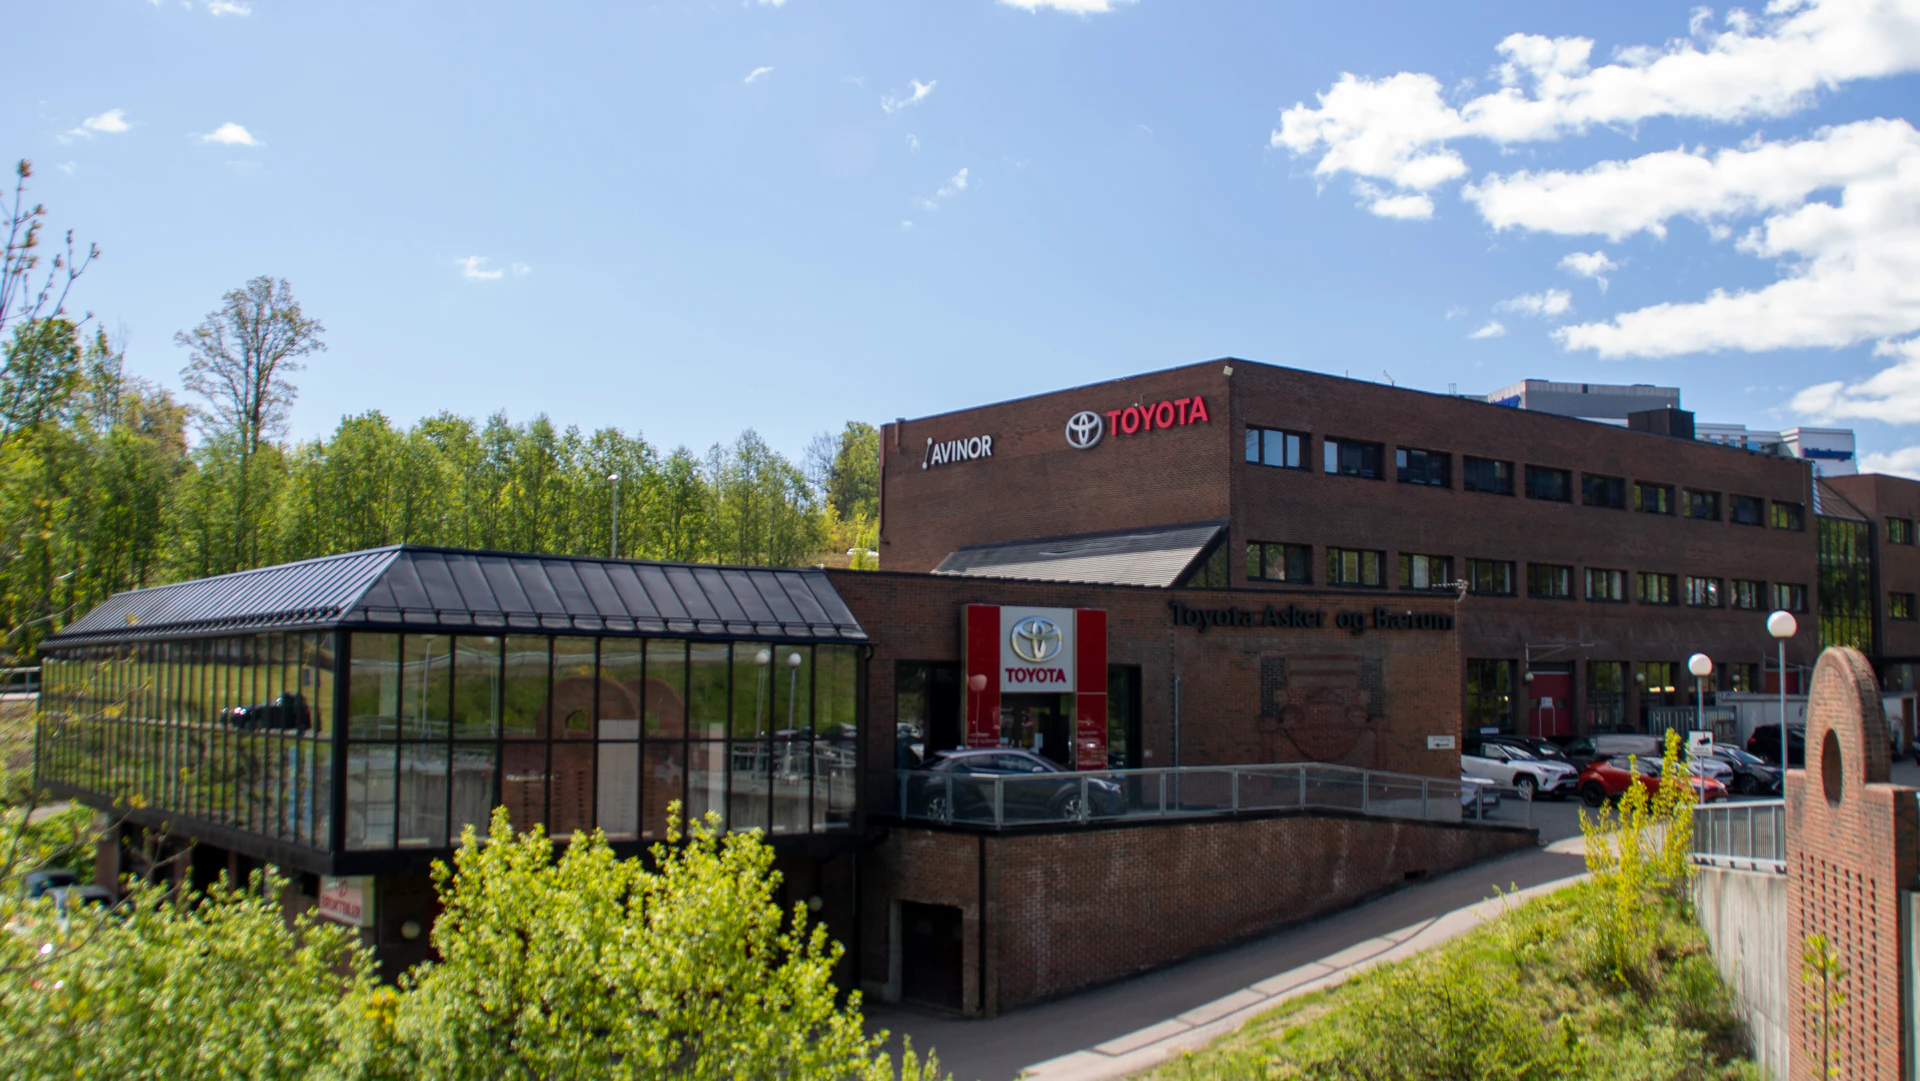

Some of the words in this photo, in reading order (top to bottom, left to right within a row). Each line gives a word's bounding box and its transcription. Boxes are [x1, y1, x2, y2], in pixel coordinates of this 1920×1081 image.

[1106, 395, 1209, 436] TOYOTA
[930, 434, 993, 465] AVINOR
[1168, 602, 1255, 633] Toyota
[1260, 604, 1327, 629] Asker
[1335, 609, 1367, 635] og
[1373, 606, 1454, 631] Bærum
[1004, 667, 1067, 683] TOYOTA
